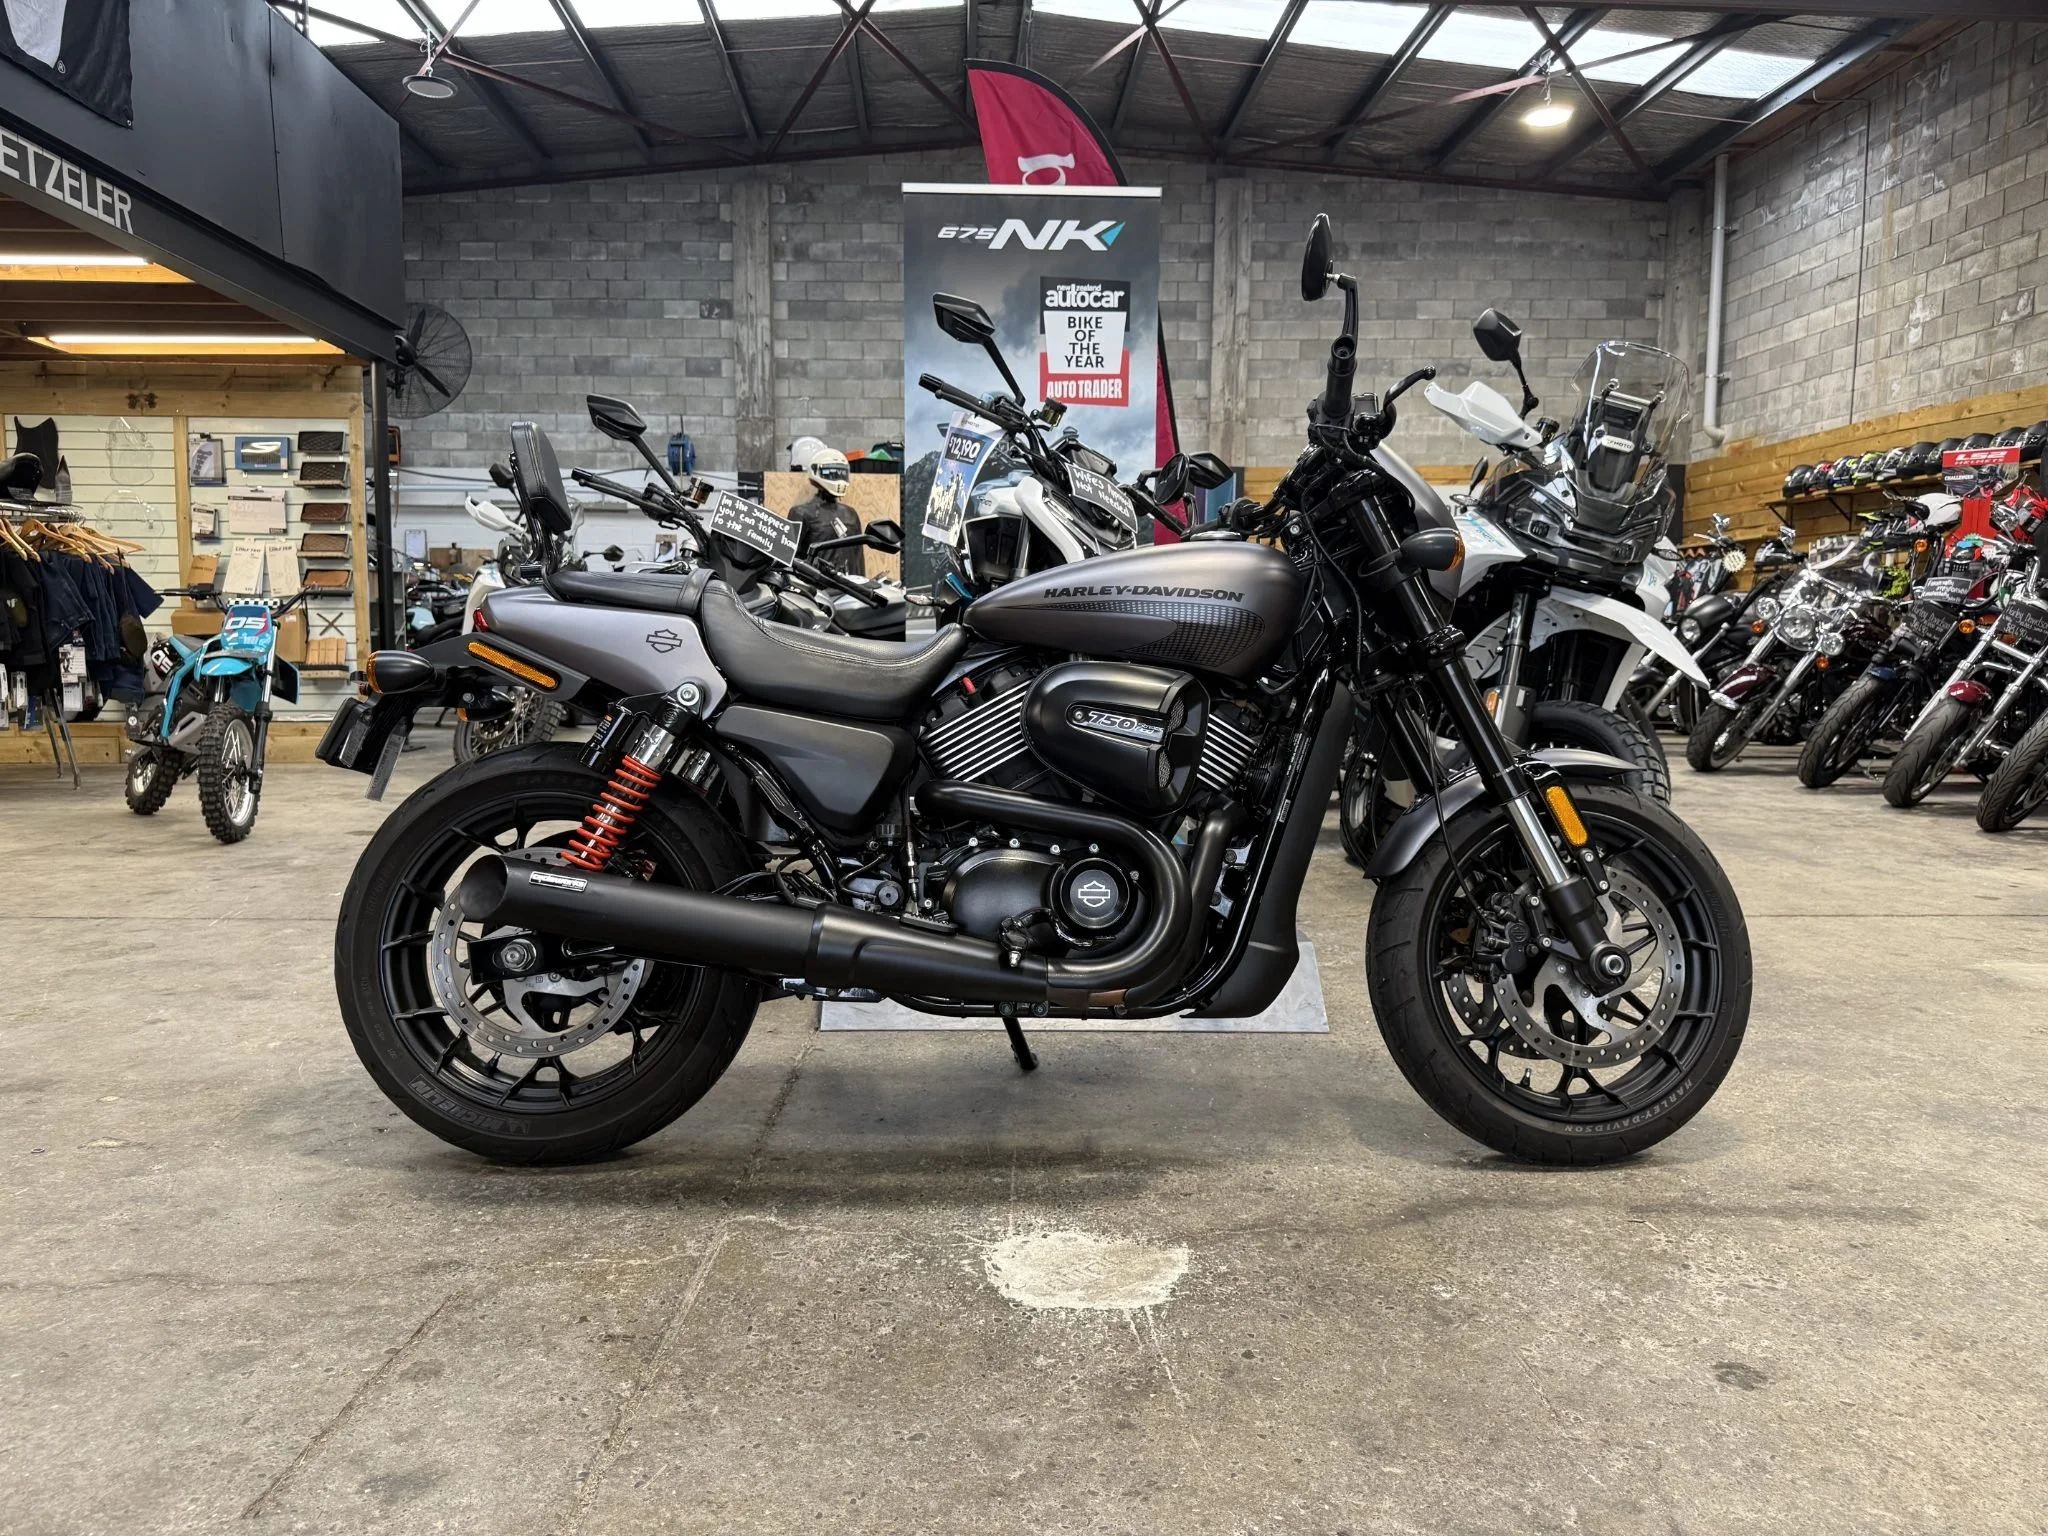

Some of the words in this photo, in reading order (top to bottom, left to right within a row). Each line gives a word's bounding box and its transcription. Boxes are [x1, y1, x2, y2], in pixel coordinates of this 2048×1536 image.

[938, 226, 997, 240] 675
[988, 219, 1120, 250] NK
[1045, 285, 1125, 308] autocar
[1067, 316, 1103, 329] BIKE
[1074, 329, 1096, 342] OF
[1069, 342, 1100, 355] THE
[1064, 355, 1105, 368] YEAR
[1046, 380, 1077, 398] AUTO
[1078, 378, 1122, 399] TRADER
[949, 436, 981, 460] $12,190
[1955, 451, 2007, 460] LS2
[1075, 479, 1093, 494] Not
[735, 500, 748, 512] the
[719, 505, 736, 517] you
[739, 513, 755, 526] can
[758, 520, 778, 539] take
[726, 519, 743, 533] the
[1044, 585, 1244, 602] HARLEY-DAVIDSON
[1088, 710, 1137, 731] 750
[410, 1079, 505, 1131] MICHELIN
[1563, 1079, 1693, 1133] HARLEY-DAVIDSON
